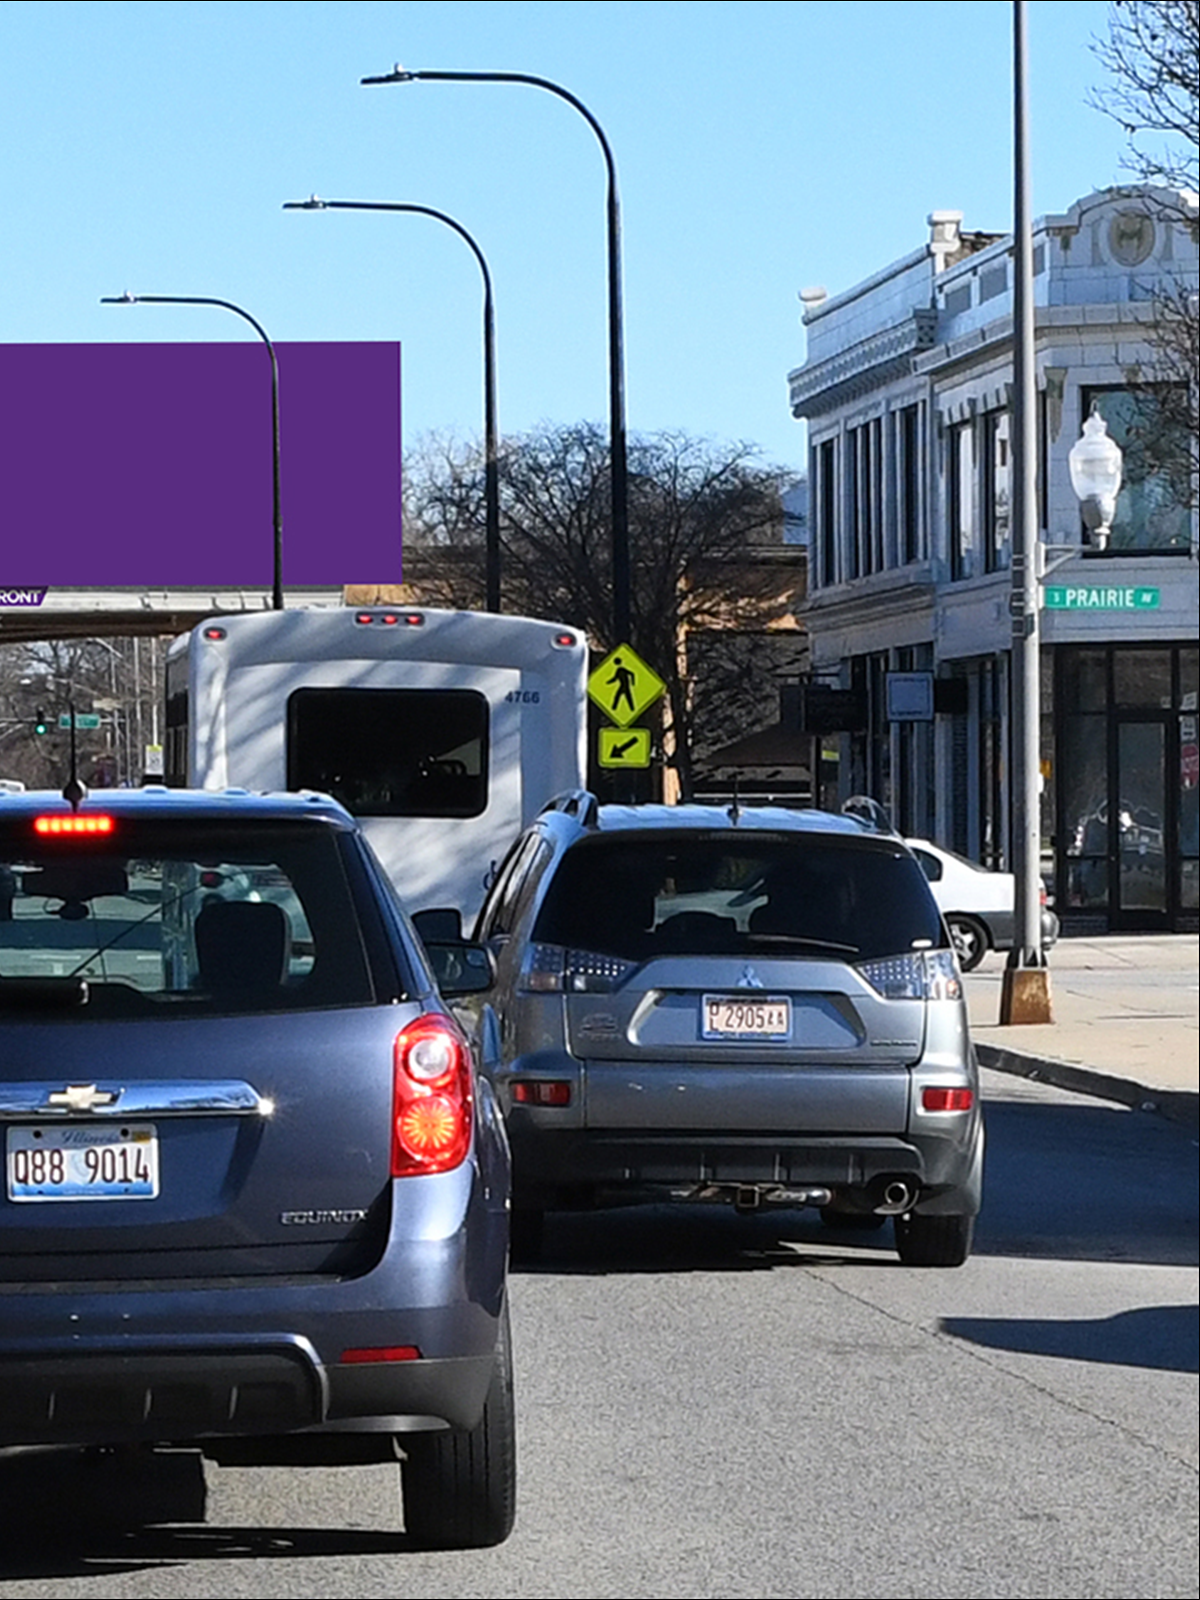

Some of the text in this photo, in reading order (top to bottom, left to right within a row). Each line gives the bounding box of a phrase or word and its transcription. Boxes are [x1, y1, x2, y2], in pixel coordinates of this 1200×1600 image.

[1066, 589, 1135, 607] PRAIRIE
[505, 691, 540, 704] 4766
[725, 1006, 765, 1028] 2905
[61, 1130, 121, 1144] Illinois
[84, 1147, 149, 1184] 9014
[281, 1209, 368, 1224] EQUINOX
